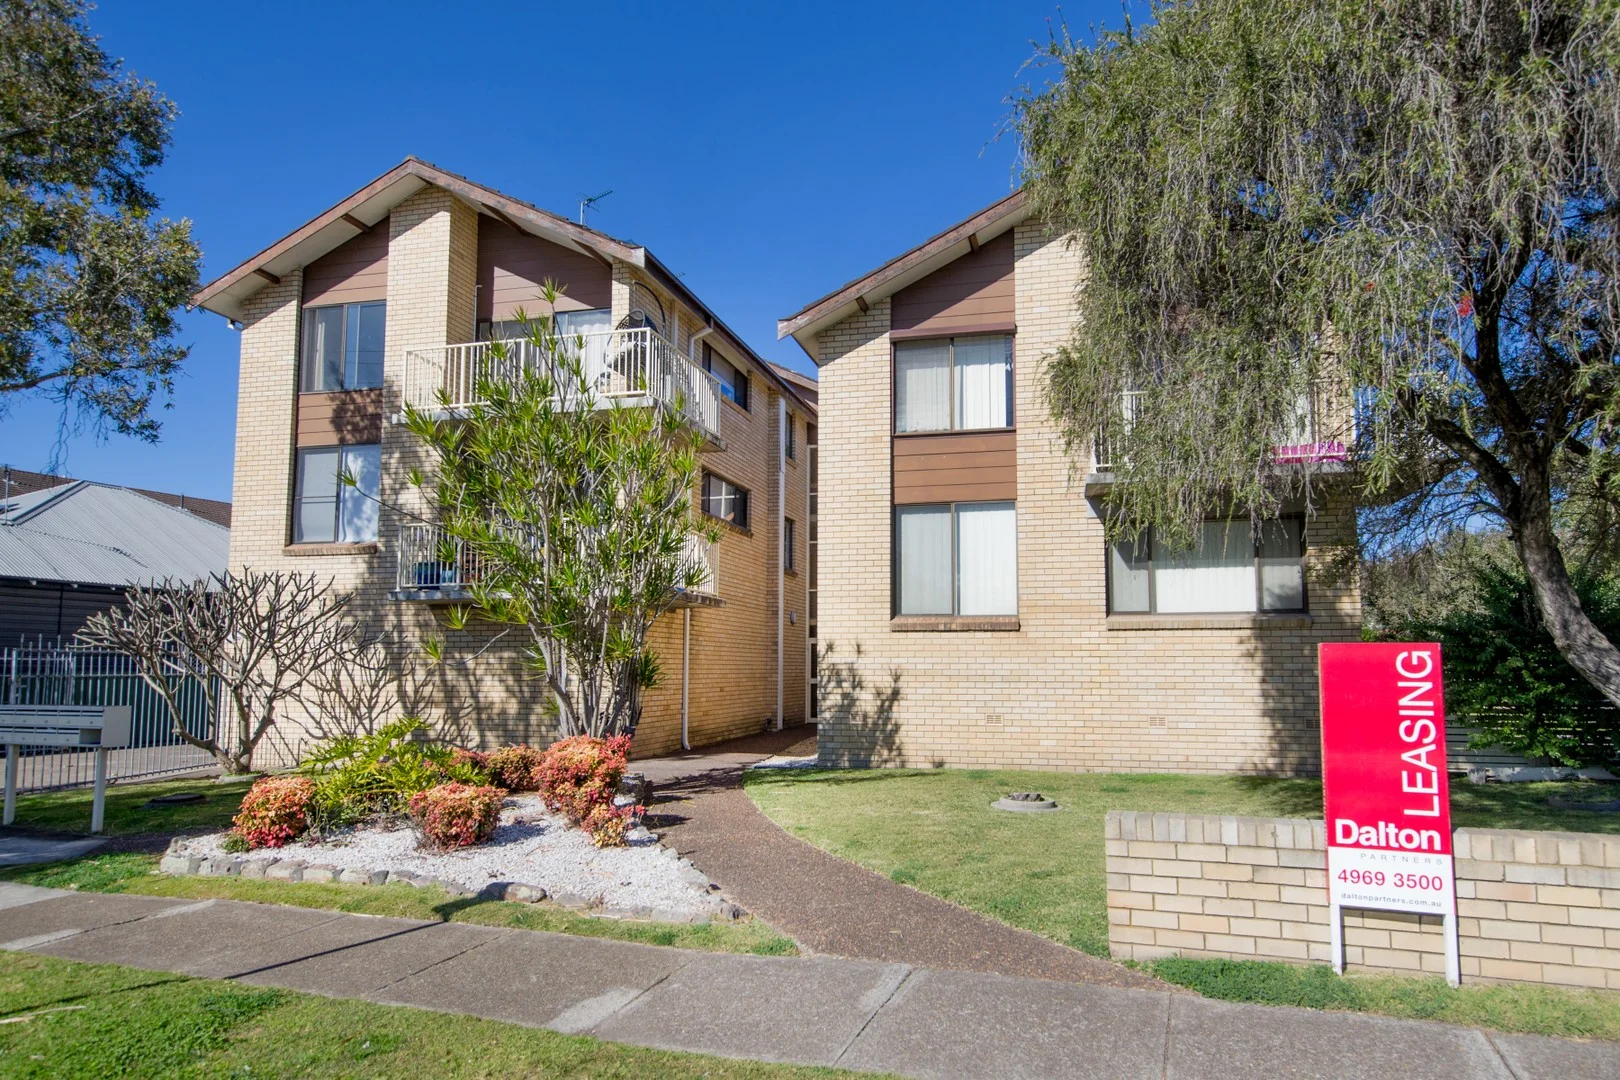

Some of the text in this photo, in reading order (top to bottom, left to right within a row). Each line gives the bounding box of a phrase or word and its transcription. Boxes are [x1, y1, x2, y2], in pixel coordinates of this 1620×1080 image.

[1395, 650, 1440, 817] LEASING
[1335, 818, 1442, 851] Dalton
[1360, 853, 1443, 865] PARTNERS
[1338, 868, 1442, 891] 4969 3500
[1341, 893, 1441, 907] daltonpartners.com.au
